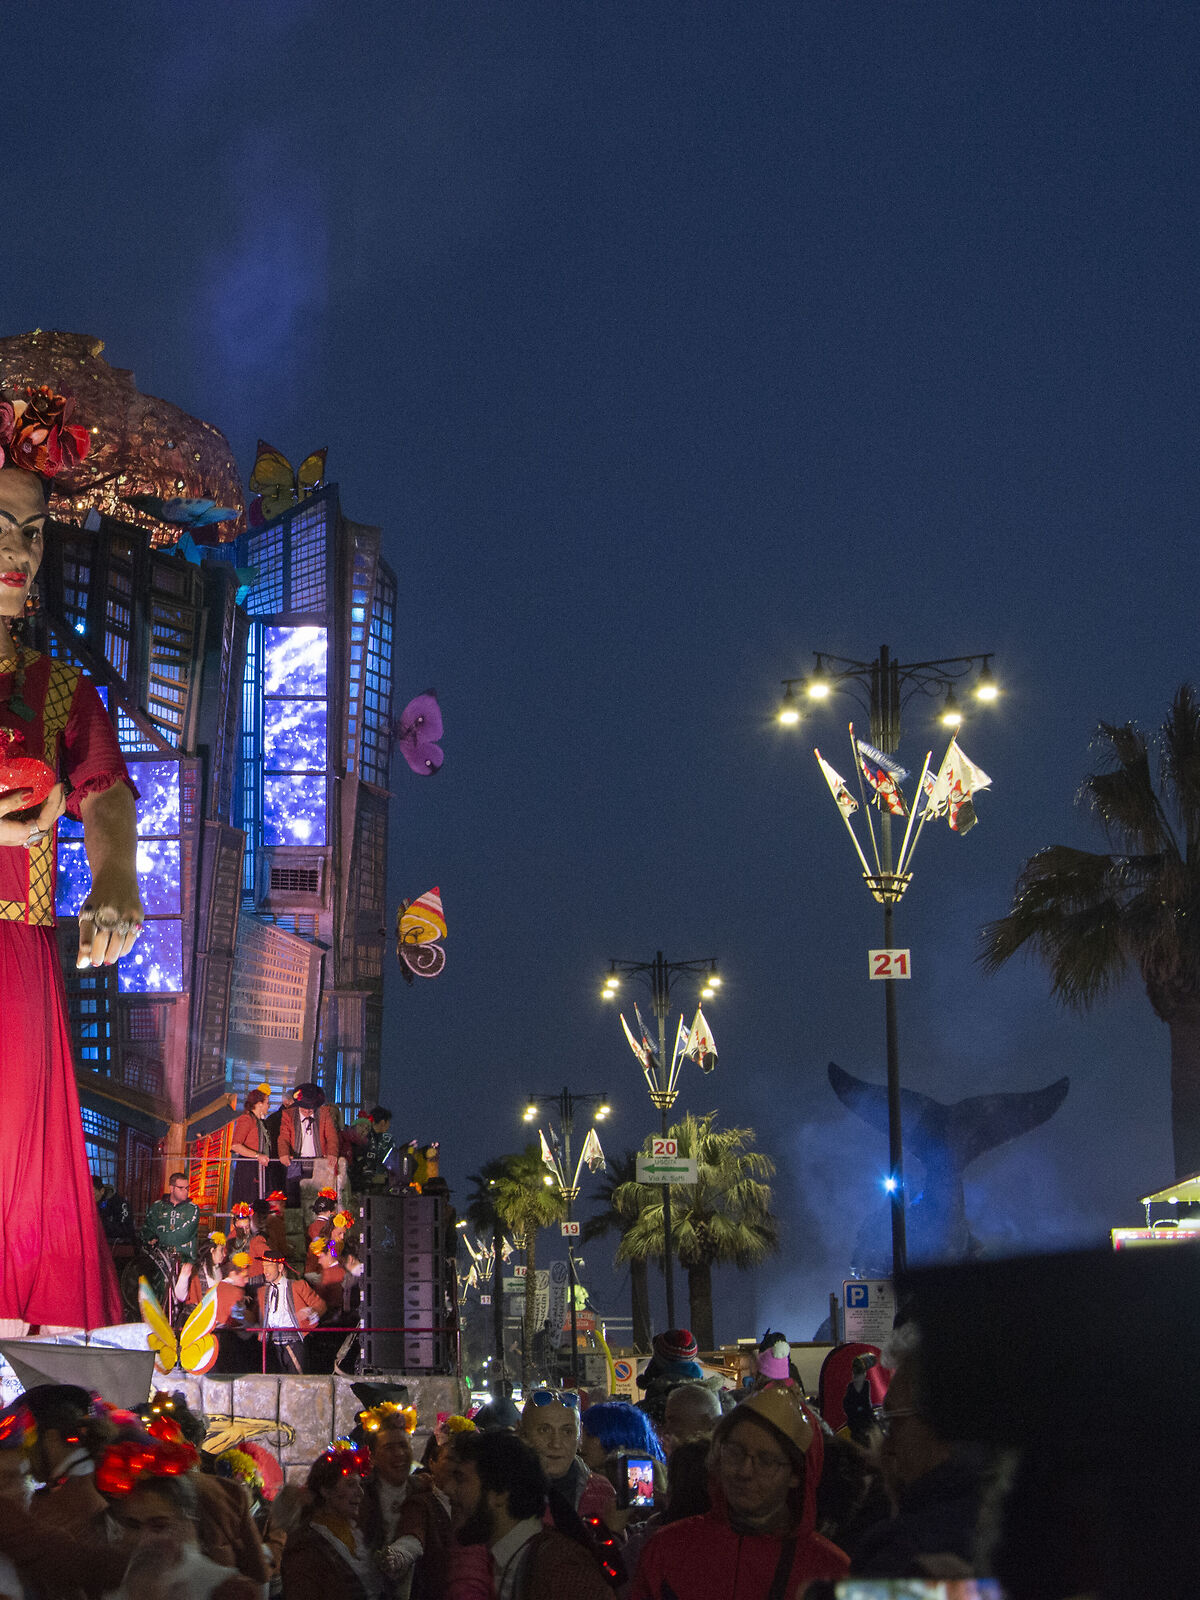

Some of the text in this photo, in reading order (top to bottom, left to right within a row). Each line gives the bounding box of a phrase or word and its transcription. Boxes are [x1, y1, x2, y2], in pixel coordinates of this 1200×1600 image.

[873, 954, 908, 976] 21
[654, 1141, 677, 1155] 20
[562, 1224, 578, 1234] 19
[515, 1267, 527, 1276] 18
[851, 1287, 865, 1306] P
